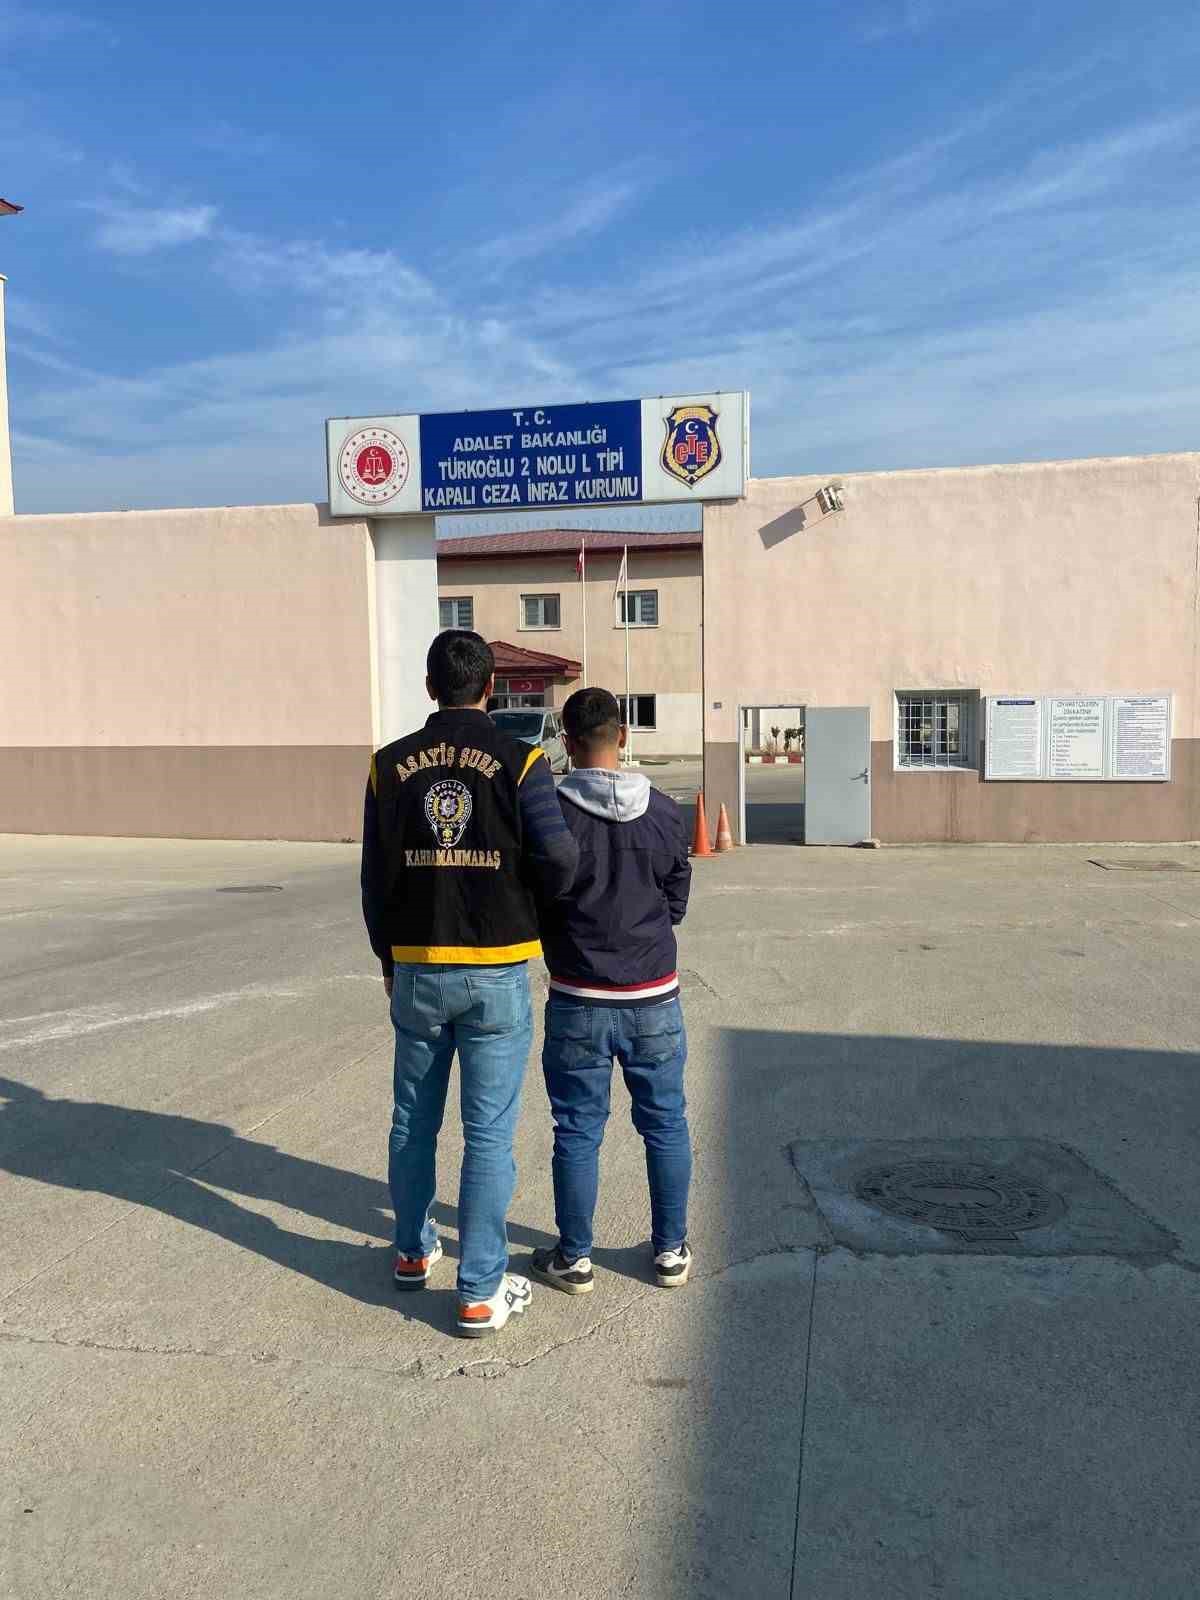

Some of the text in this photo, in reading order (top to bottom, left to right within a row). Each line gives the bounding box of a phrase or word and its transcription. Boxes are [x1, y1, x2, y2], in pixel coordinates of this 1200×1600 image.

[453, 424, 607, 453] ADALET BAKANLIĞI
[438, 446, 624, 481] TÜRKOĞLU 2 NOLU L TİPİ
[424, 476, 639, 507] KAPALI CEZA İNFAZ KURUMU
[395, 742, 455, 783] ASAYİŞ
